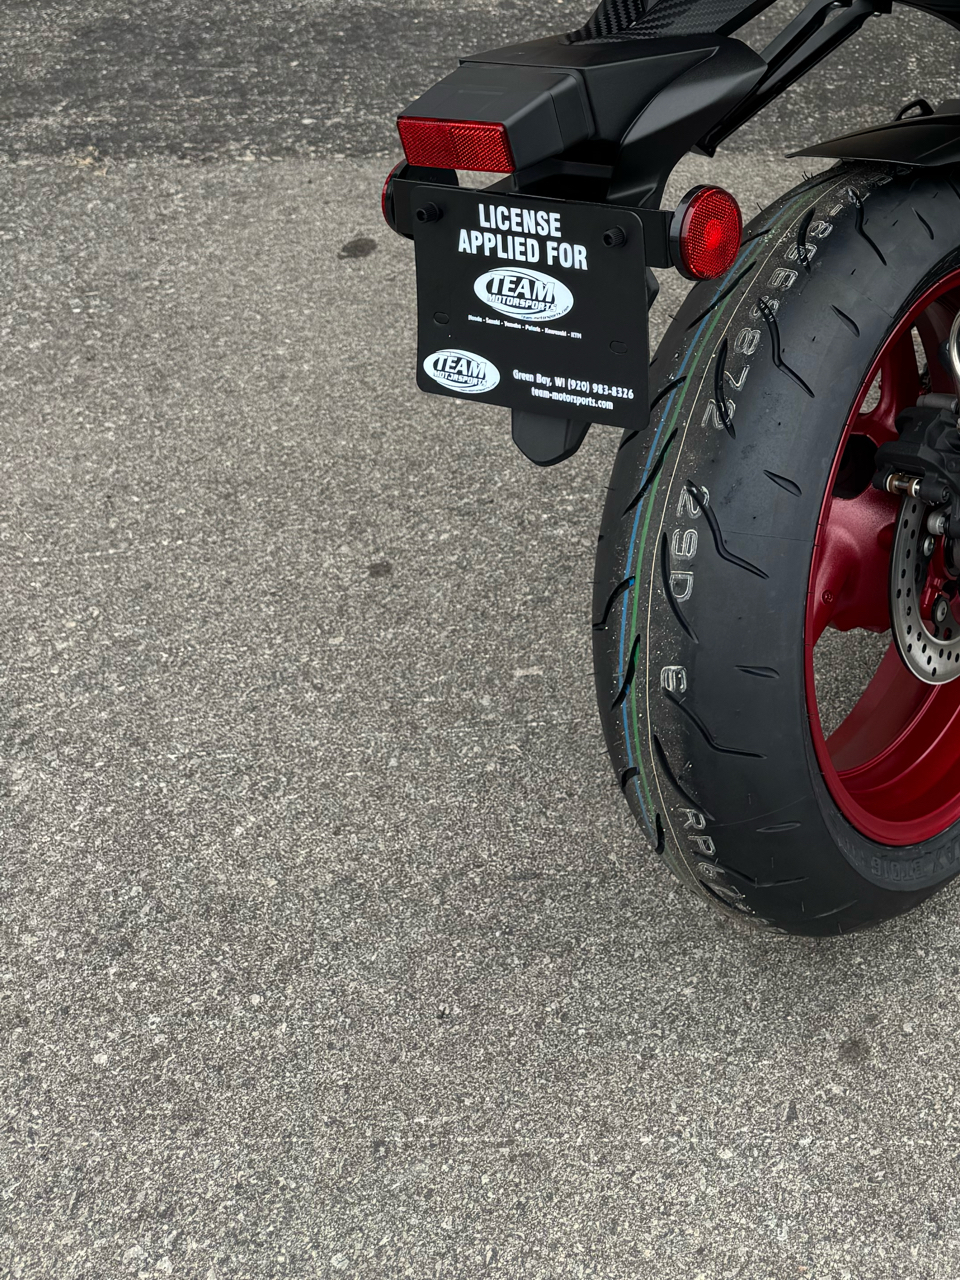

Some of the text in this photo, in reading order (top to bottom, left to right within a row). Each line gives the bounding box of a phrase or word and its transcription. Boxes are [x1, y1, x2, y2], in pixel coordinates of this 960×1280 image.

[478, 203, 562, 238] LICENSE
[458, 228, 589, 271] APPLIED FOR
[489, 273, 556, 303] TEAM
[486, 293, 558, 313] MOTORSPORTS
[433, 370, 488, 387] MOTORSPORTS
[437, 353, 487, 379] TEAM
[512, 369, 635, 400] Green Bay, WI (920) 983-8326
[530, 386, 614, 410] team-motorsports.com
